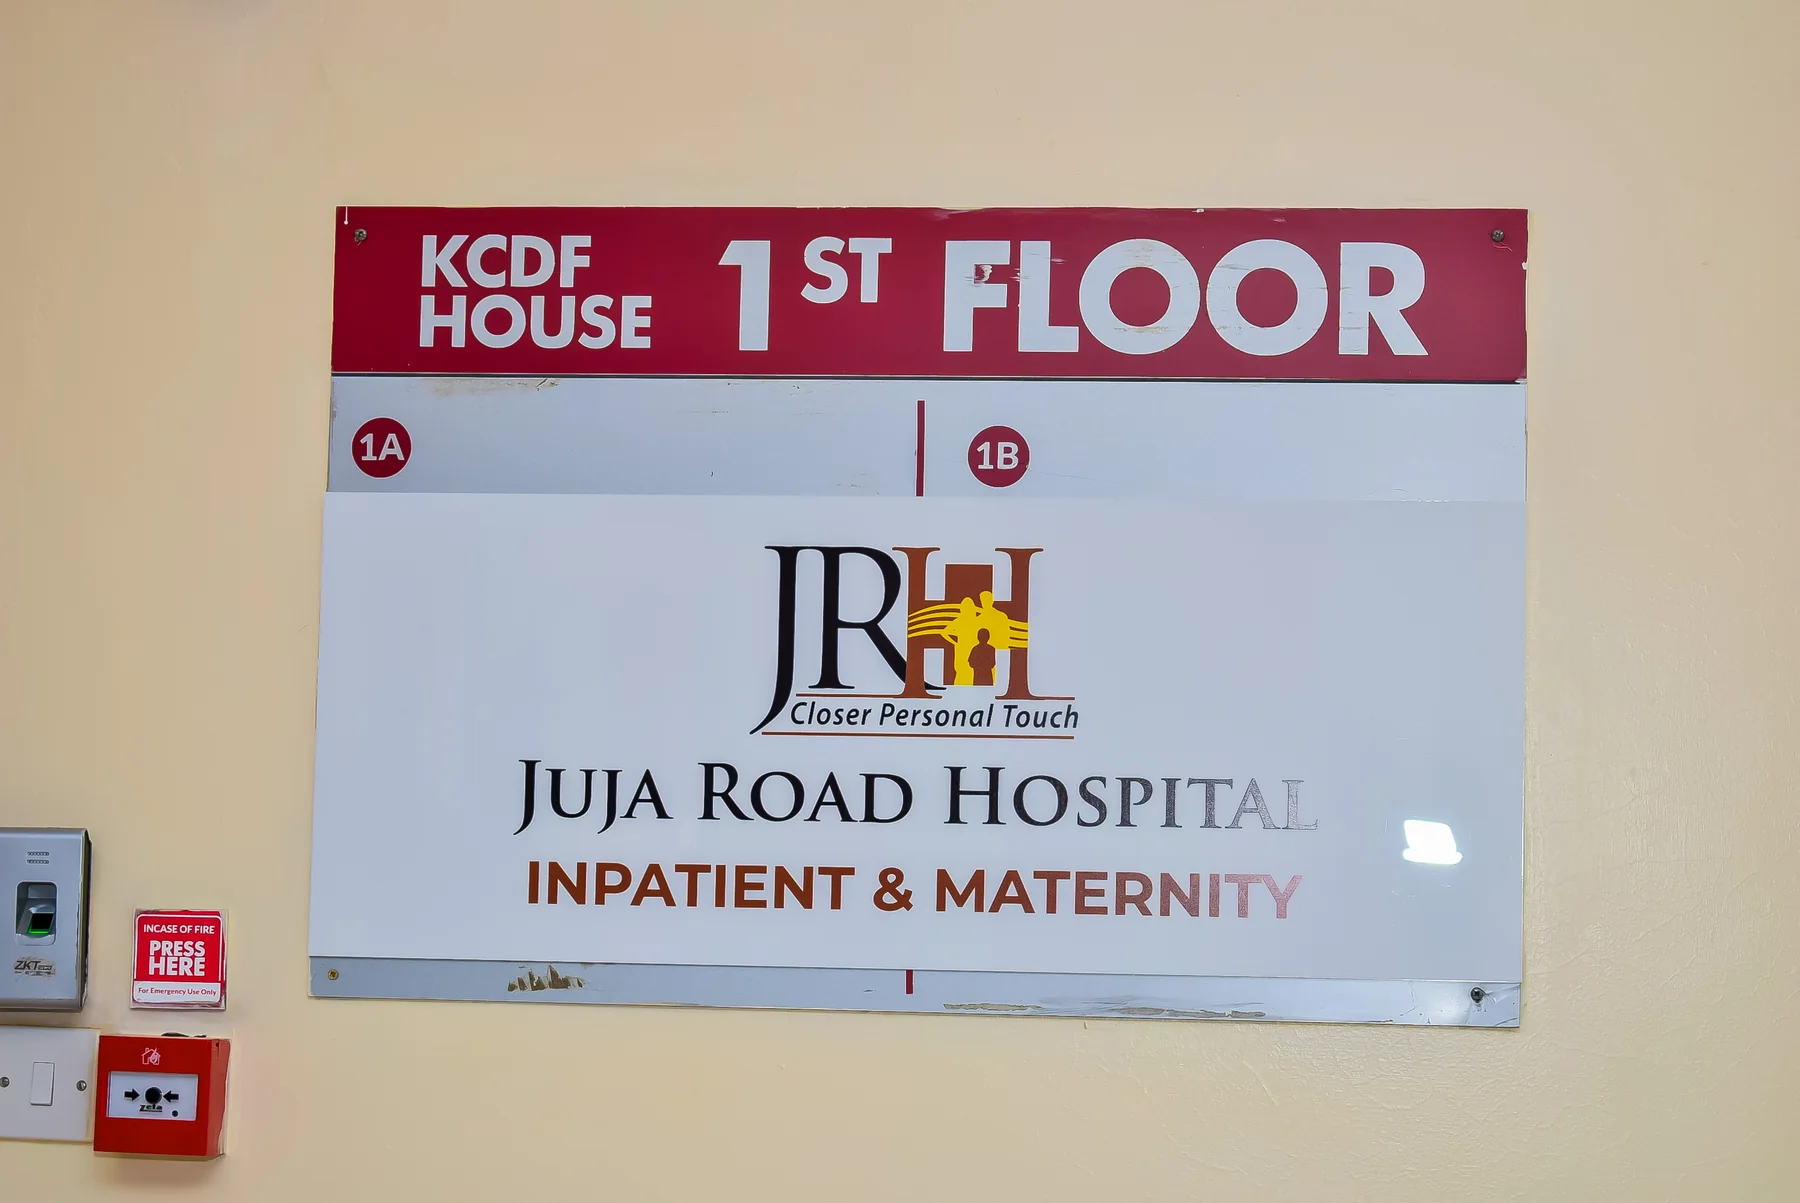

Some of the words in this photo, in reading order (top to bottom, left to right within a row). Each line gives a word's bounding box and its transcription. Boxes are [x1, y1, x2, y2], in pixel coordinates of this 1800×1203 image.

[421, 234, 592, 288] KCDF
[718, 240, 771, 352] 1
[800, 236, 893, 304] ST
[943, 238, 1429, 356] FLOOR
[419, 294, 652, 349] HOUSE
[359, 432, 405, 461] 1A
[976, 442, 1019, 470] 1B
[749, 544, 1044, 735] JRH
[790, 701, 871, 728] Closer
[878, 701, 994, 729] Personal
[1001, 704, 1080, 731] Touch
[514, 759, 673, 835] JUJA
[698, 761, 913, 826] ROAD
[943, 765, 1319, 832] HOSPITAL
[526, 860, 855, 910] INPATIENT
[874, 866, 914, 912] &
[935, 868, 1304, 921] MATERNITY
[143, 924, 178, 934] INCASE
[179, 925, 193, 934] OF
[194, 925, 215, 934] FIRE
[149, 940, 206, 957] PRESS
[148, 956, 206, 976] HERE
[150, 987, 186, 996] Emergency
[200, 988, 217, 997] Only
